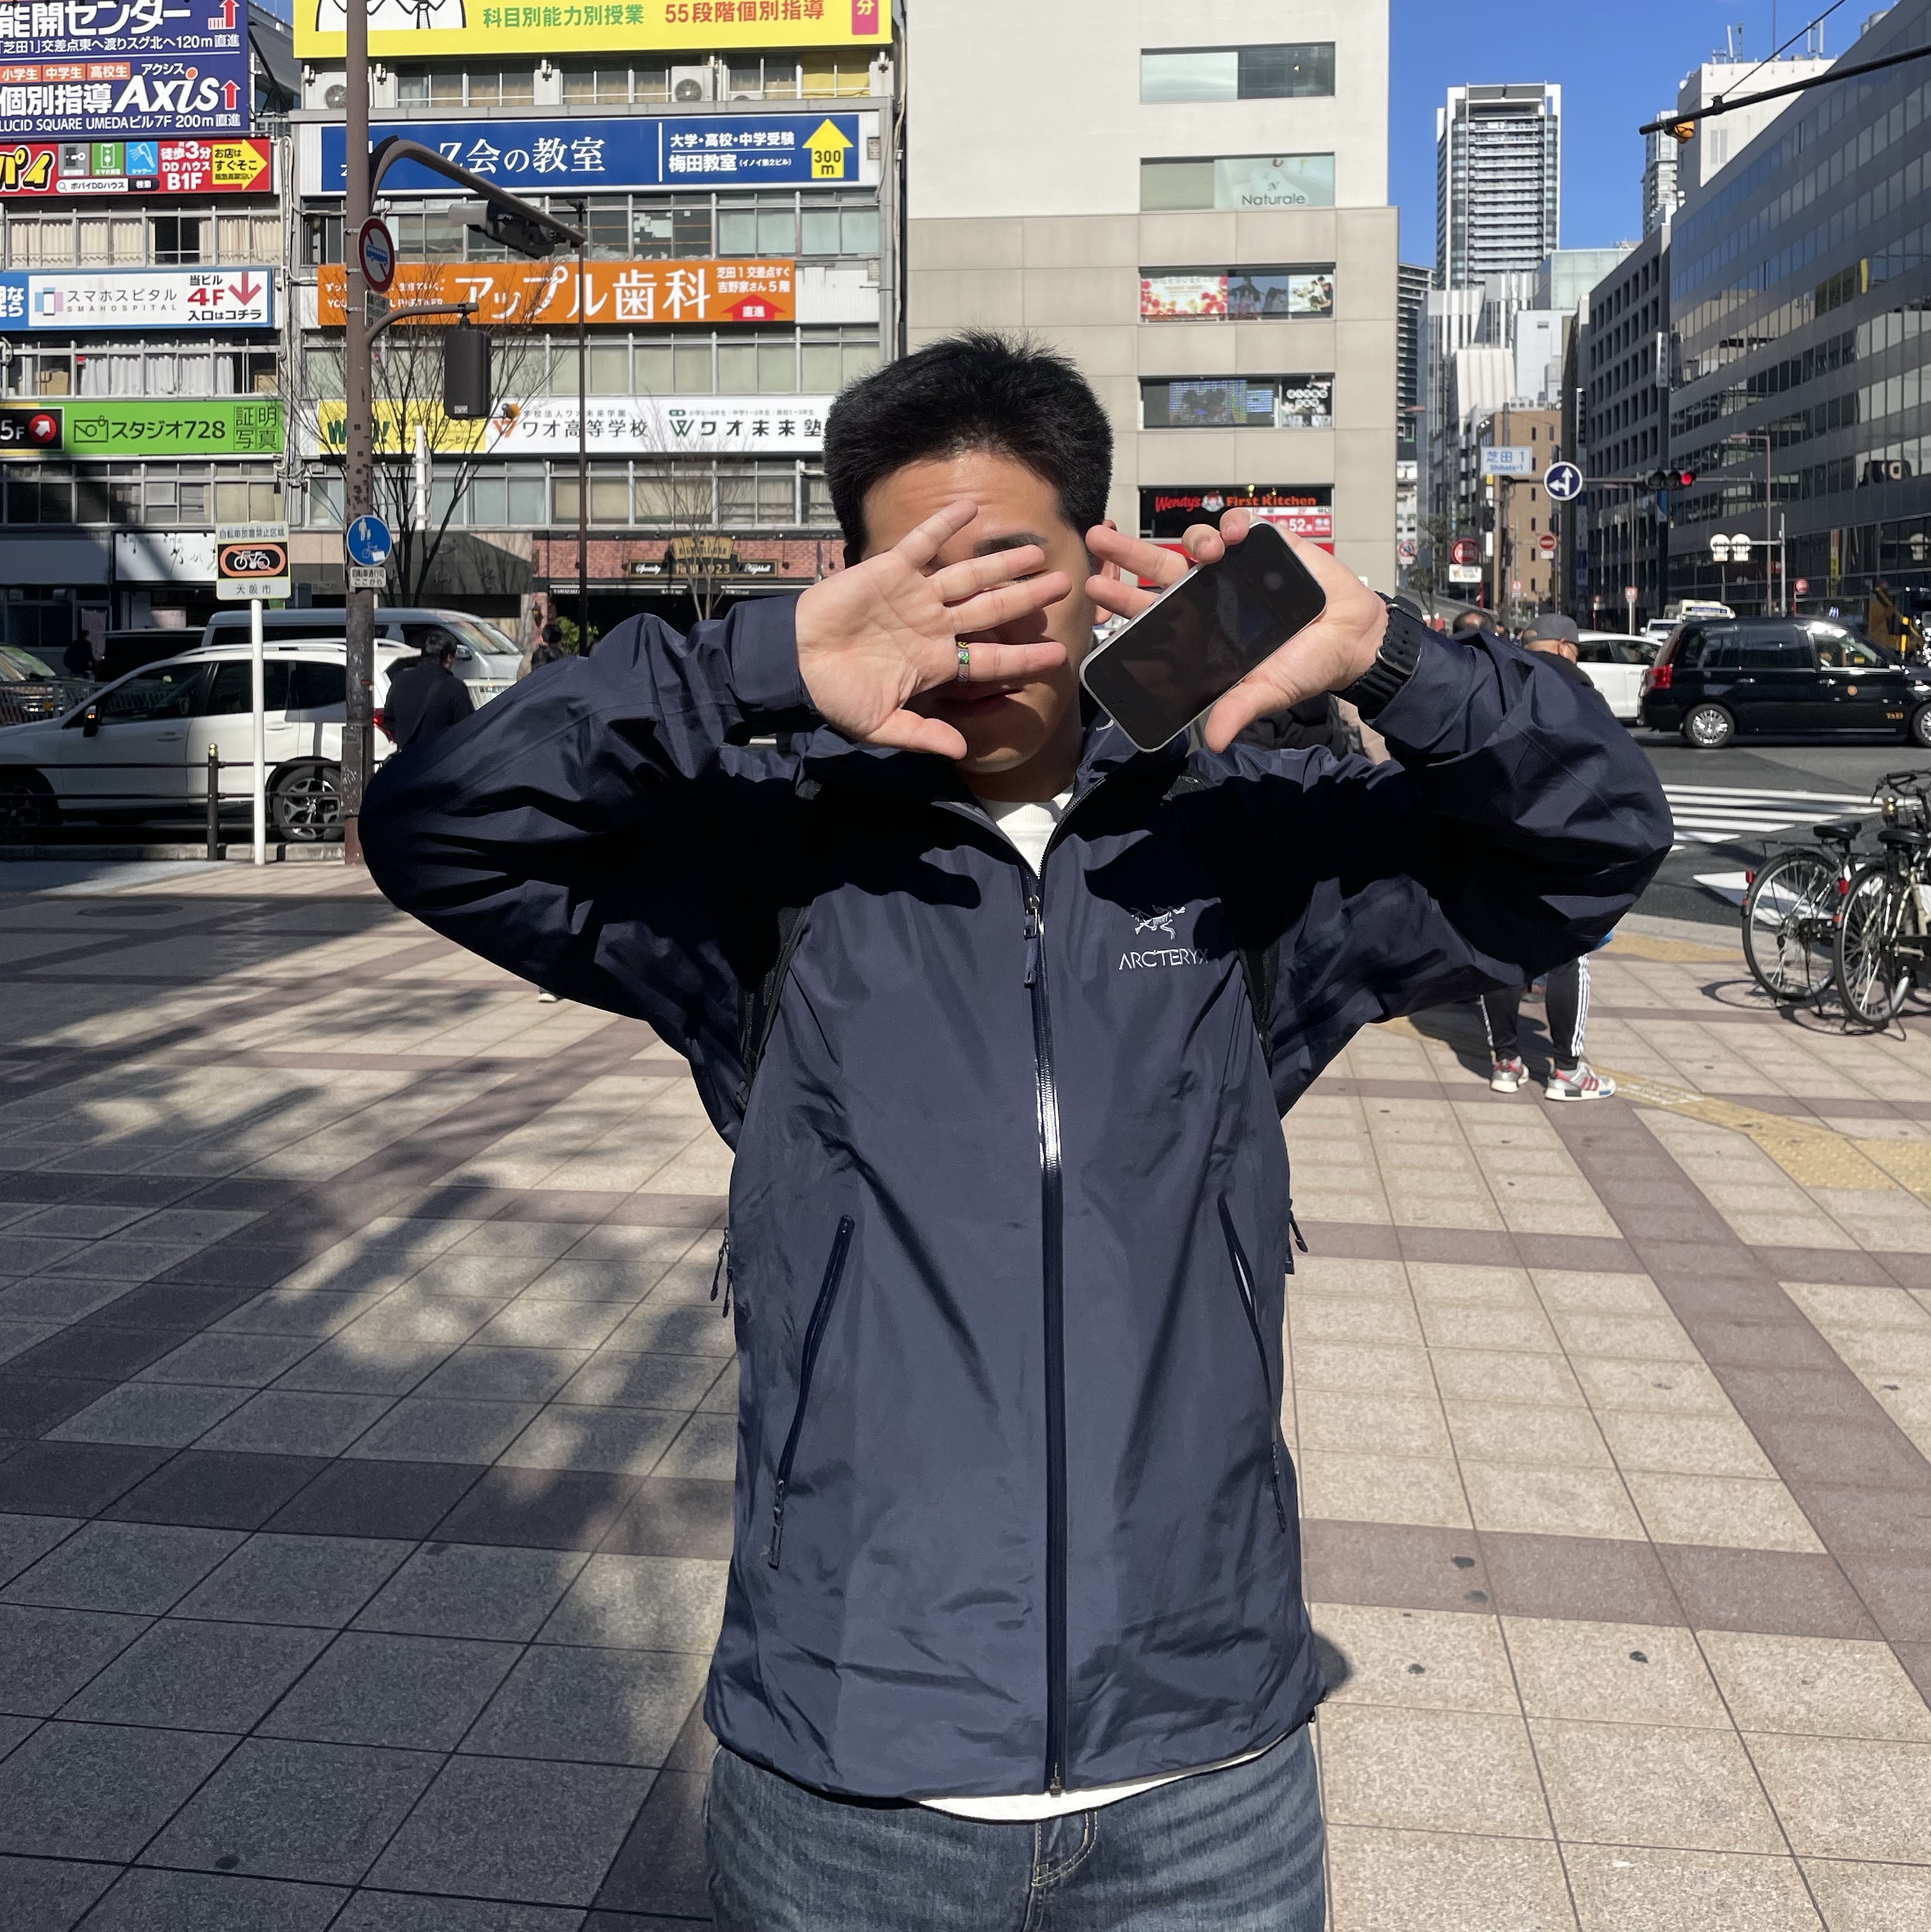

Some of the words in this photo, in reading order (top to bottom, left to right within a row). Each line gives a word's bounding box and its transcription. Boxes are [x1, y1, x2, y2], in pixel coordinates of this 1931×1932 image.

[0, 0, 191, 38] 能開センター
[483, 5, 645, 27] 科目別能力別授業
[665, 0, 824, 22] 55段階個別指導
[2, 68, 38, 81] 小学生
[45, 66, 82, 79] 中学生
[91, 65, 128, 78] 高校生
[141, 63, 185, 75] アクシス
[0, 83, 112, 116] 個別指導
[112, 67, 220, 114] Axis
[36, 118, 82, 131] SQUARE
[670, 132, 795, 148] 大学・高校・中学受験
[215, 148, 241, 158] お店は
[814, 151, 841, 163] 300
[162, 162, 179, 172] DD
[181, 162, 211, 171] ハウス
[215, 160, 257, 171] すぐそこ
[669, 154, 737, 172] 梅田教室
[821, 164, 834, 175] m
[167, 172, 202, 190] B1F
[1242, 192, 1305, 206] Naturale
[190, 275, 223, 286] 当ビル
[68, 288, 177, 302] スマホスピタル
[187, 287, 225, 307] 4F
[454, 265, 711, 319] アップル歯科
[188, 309, 262, 321] 入口はコチラ
[236, 406, 280, 427] 証明
[0, 419, 24, 441] 5F
[112, 420, 226, 440] スタジオ728
[523, 419, 648, 439] ワオ高等学校
[701, 419, 822, 437] ワオ未来塾
[236, 429, 279, 449] 写真
[1156, 496, 1201, 512] Wendy's
[1226, 496, 1259, 506] First
[1262, 495, 1317, 506] Kitchen
